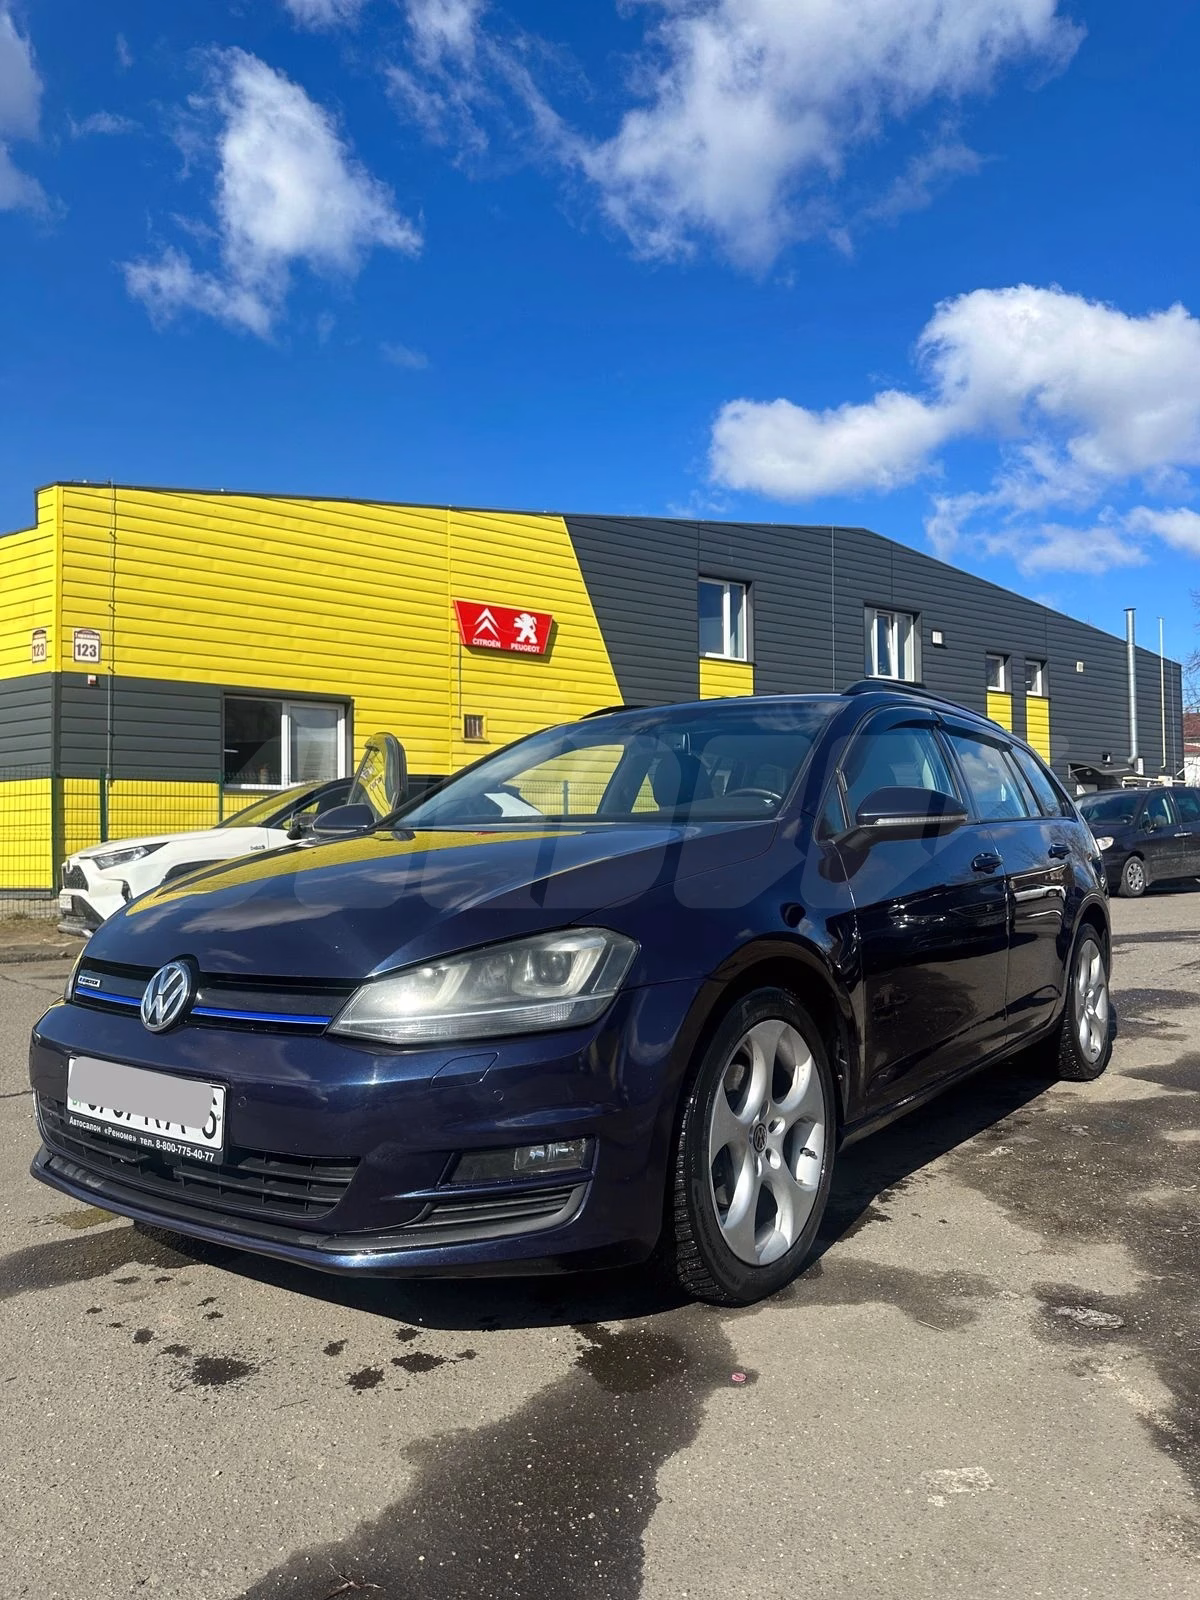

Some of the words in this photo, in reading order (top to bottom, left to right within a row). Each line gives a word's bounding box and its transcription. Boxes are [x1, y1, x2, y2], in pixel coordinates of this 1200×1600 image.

[33, 643, 45, 656] 123
[76, 644, 97, 657] 123
[511, 643, 540, 653] PEUGEOT
[69, 1116, 101, 1133] Автосалон
[104, 1126, 137, 1142] «Реноме»
[140, 1136, 154, 1147] тел.
[155, 1139, 215, 1162] 8-800-775-40-77
